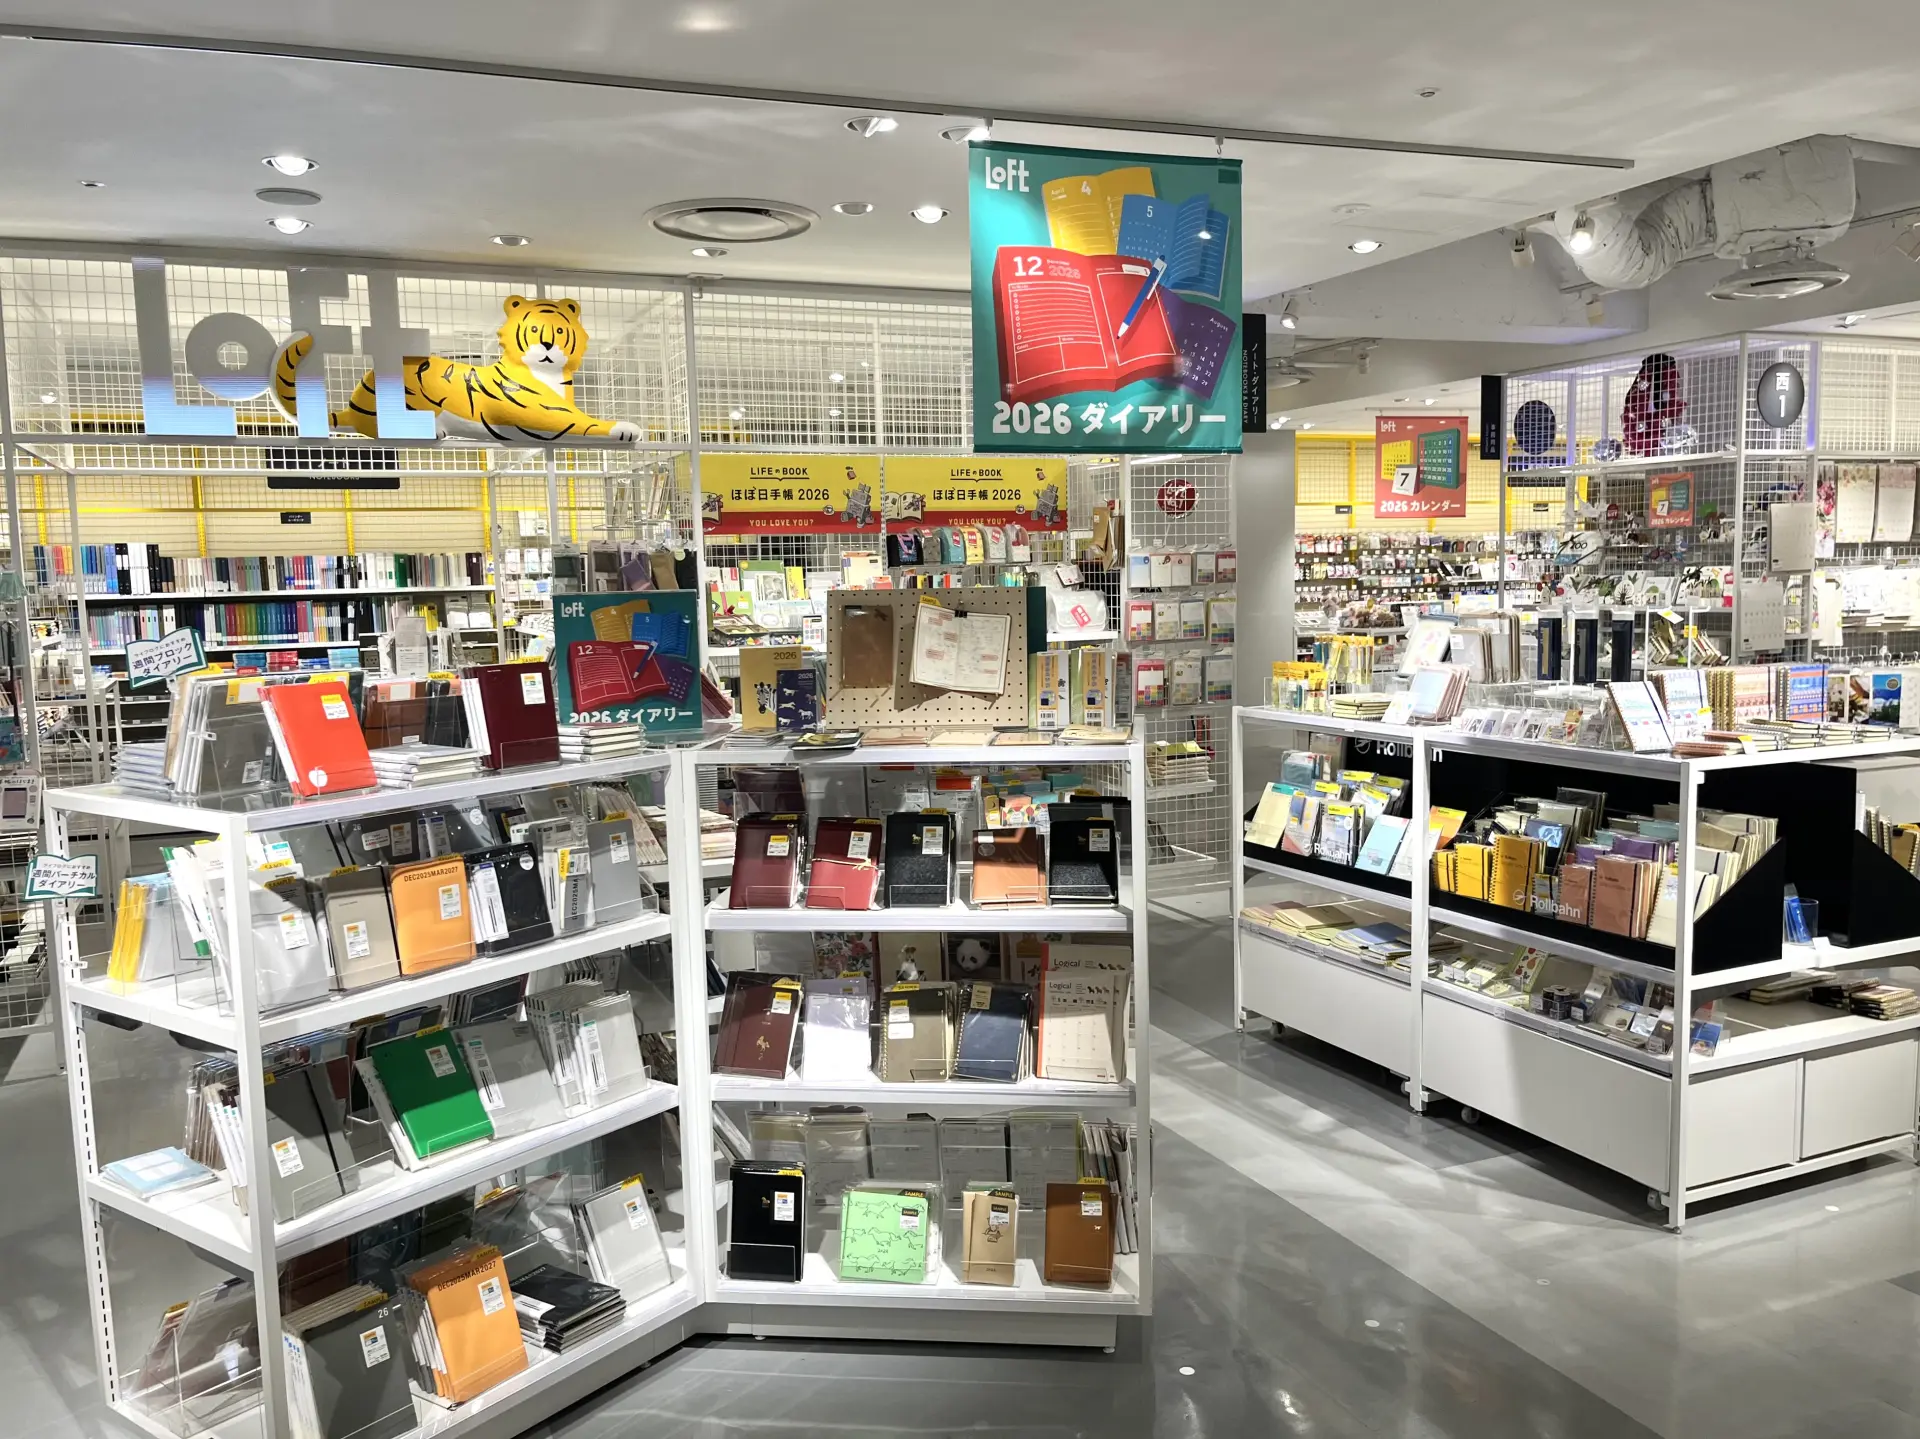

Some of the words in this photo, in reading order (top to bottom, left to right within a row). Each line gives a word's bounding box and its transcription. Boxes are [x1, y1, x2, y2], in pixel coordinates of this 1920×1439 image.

[985, 156, 1030, 192] Loft
[1081, 181, 1092, 196] 4
[1146, 206, 1153, 218] 5
[1013, 255, 1044, 277] 12
[1209, 317, 1229, 332] August
[131, 256, 437, 440] Loft
[1775, 372, 1791, 391] 西
[1778, 394, 1786, 418] 1
[992, 400, 1073, 434] 2026
[1079, 402, 1227, 434] ダイアリー
[1381, 420, 1397, 433] Loft
[750, 467, 773, 476] LIFE
[782, 467, 808, 475] BOOK
[950, 469, 971, 477] LIFE
[979, 468, 1002, 477] BOOK
[1400, 472, 1410, 487] 7
[730, 486, 794, 501] ほぼ日手帳
[798, 488, 830, 501] 2026
[932, 486, 989, 501] ほぼ日手帳
[992, 489, 1022, 501] 2026
[1380, 500, 1409, 513] 2026
[1410, 499, 1461, 512] カレンダー
[749, 519, 767, 527] YOU
[792, 518, 814, 527] YOU?
[986, 517, 1006, 525] YOU?
[560, 602, 585, 618] Loft
[577, 644, 594, 656] 12
[773, 651, 797, 660] 2026
[798, 672, 813, 680] 2026
[569, 710, 612, 724] 2026
[615, 706, 694, 724] ダイアリー
[1376, 740, 1443, 763] Rollbn
[32, 869, 96, 879] 週間バーチカル
[403, 865, 459, 883] DEC2025MAR2027
[38, 880, 86, 888] ダイアリー
[1529, 894, 1582, 919] Rollbahn
[1053, 958, 1081, 968] Logical
[1049, 981, 1072, 991] Logical
[437, 1261, 497, 1292] DEC2025MAR2027
[377, 1307, 389, 1319] 26
